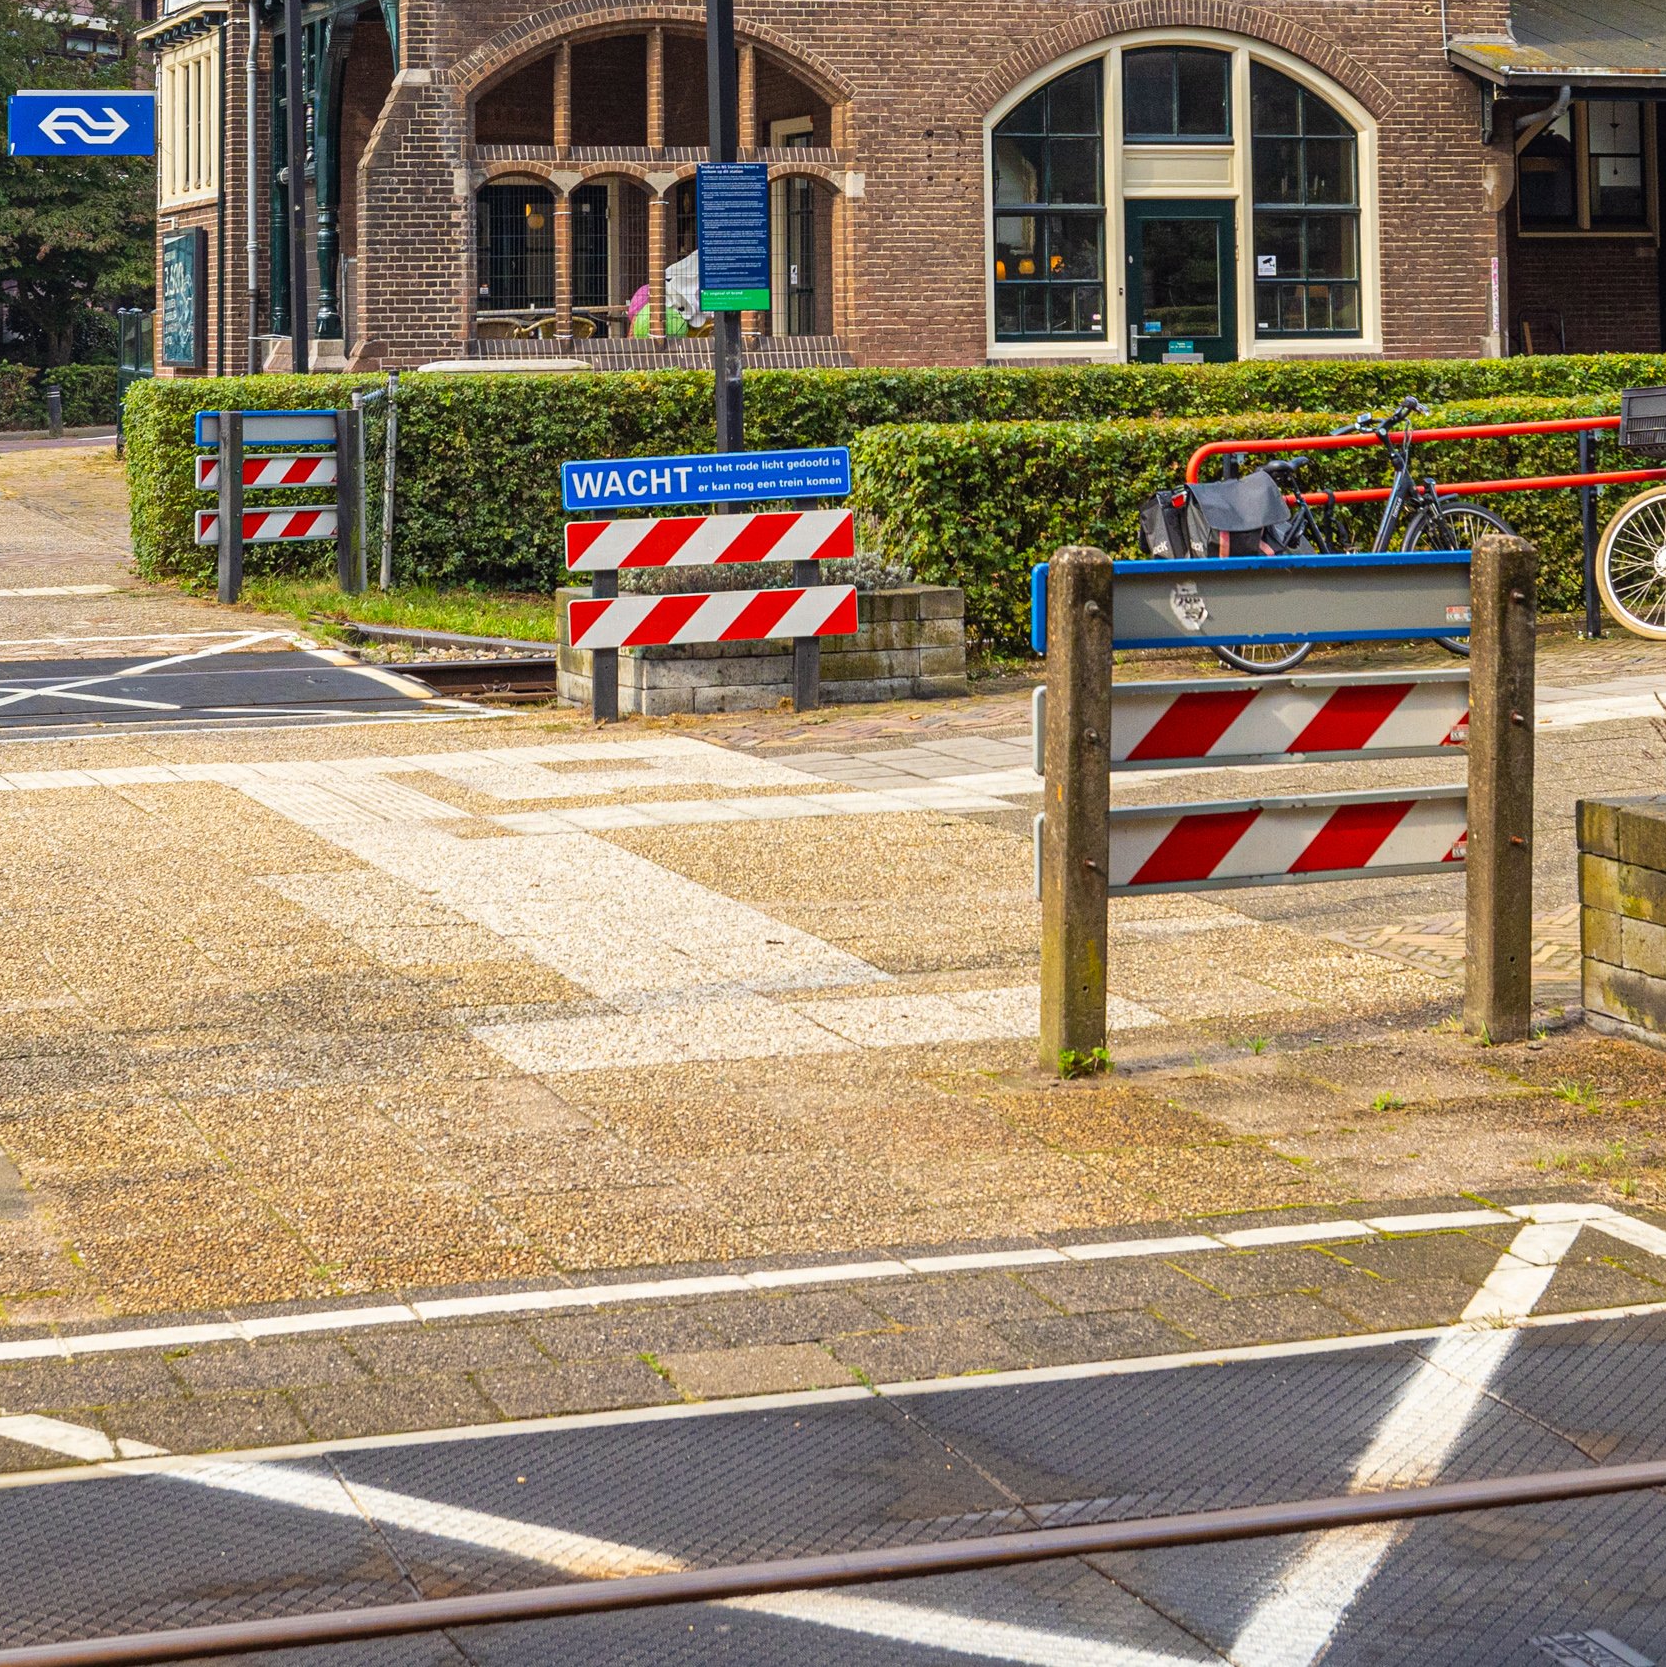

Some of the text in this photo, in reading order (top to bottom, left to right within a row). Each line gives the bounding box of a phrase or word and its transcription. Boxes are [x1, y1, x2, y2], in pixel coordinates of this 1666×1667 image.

[571, 456, 841, 499] WACHT tot het rode licht gedoofd is
[698, 475, 842, 492] er kan nog een trein komen
